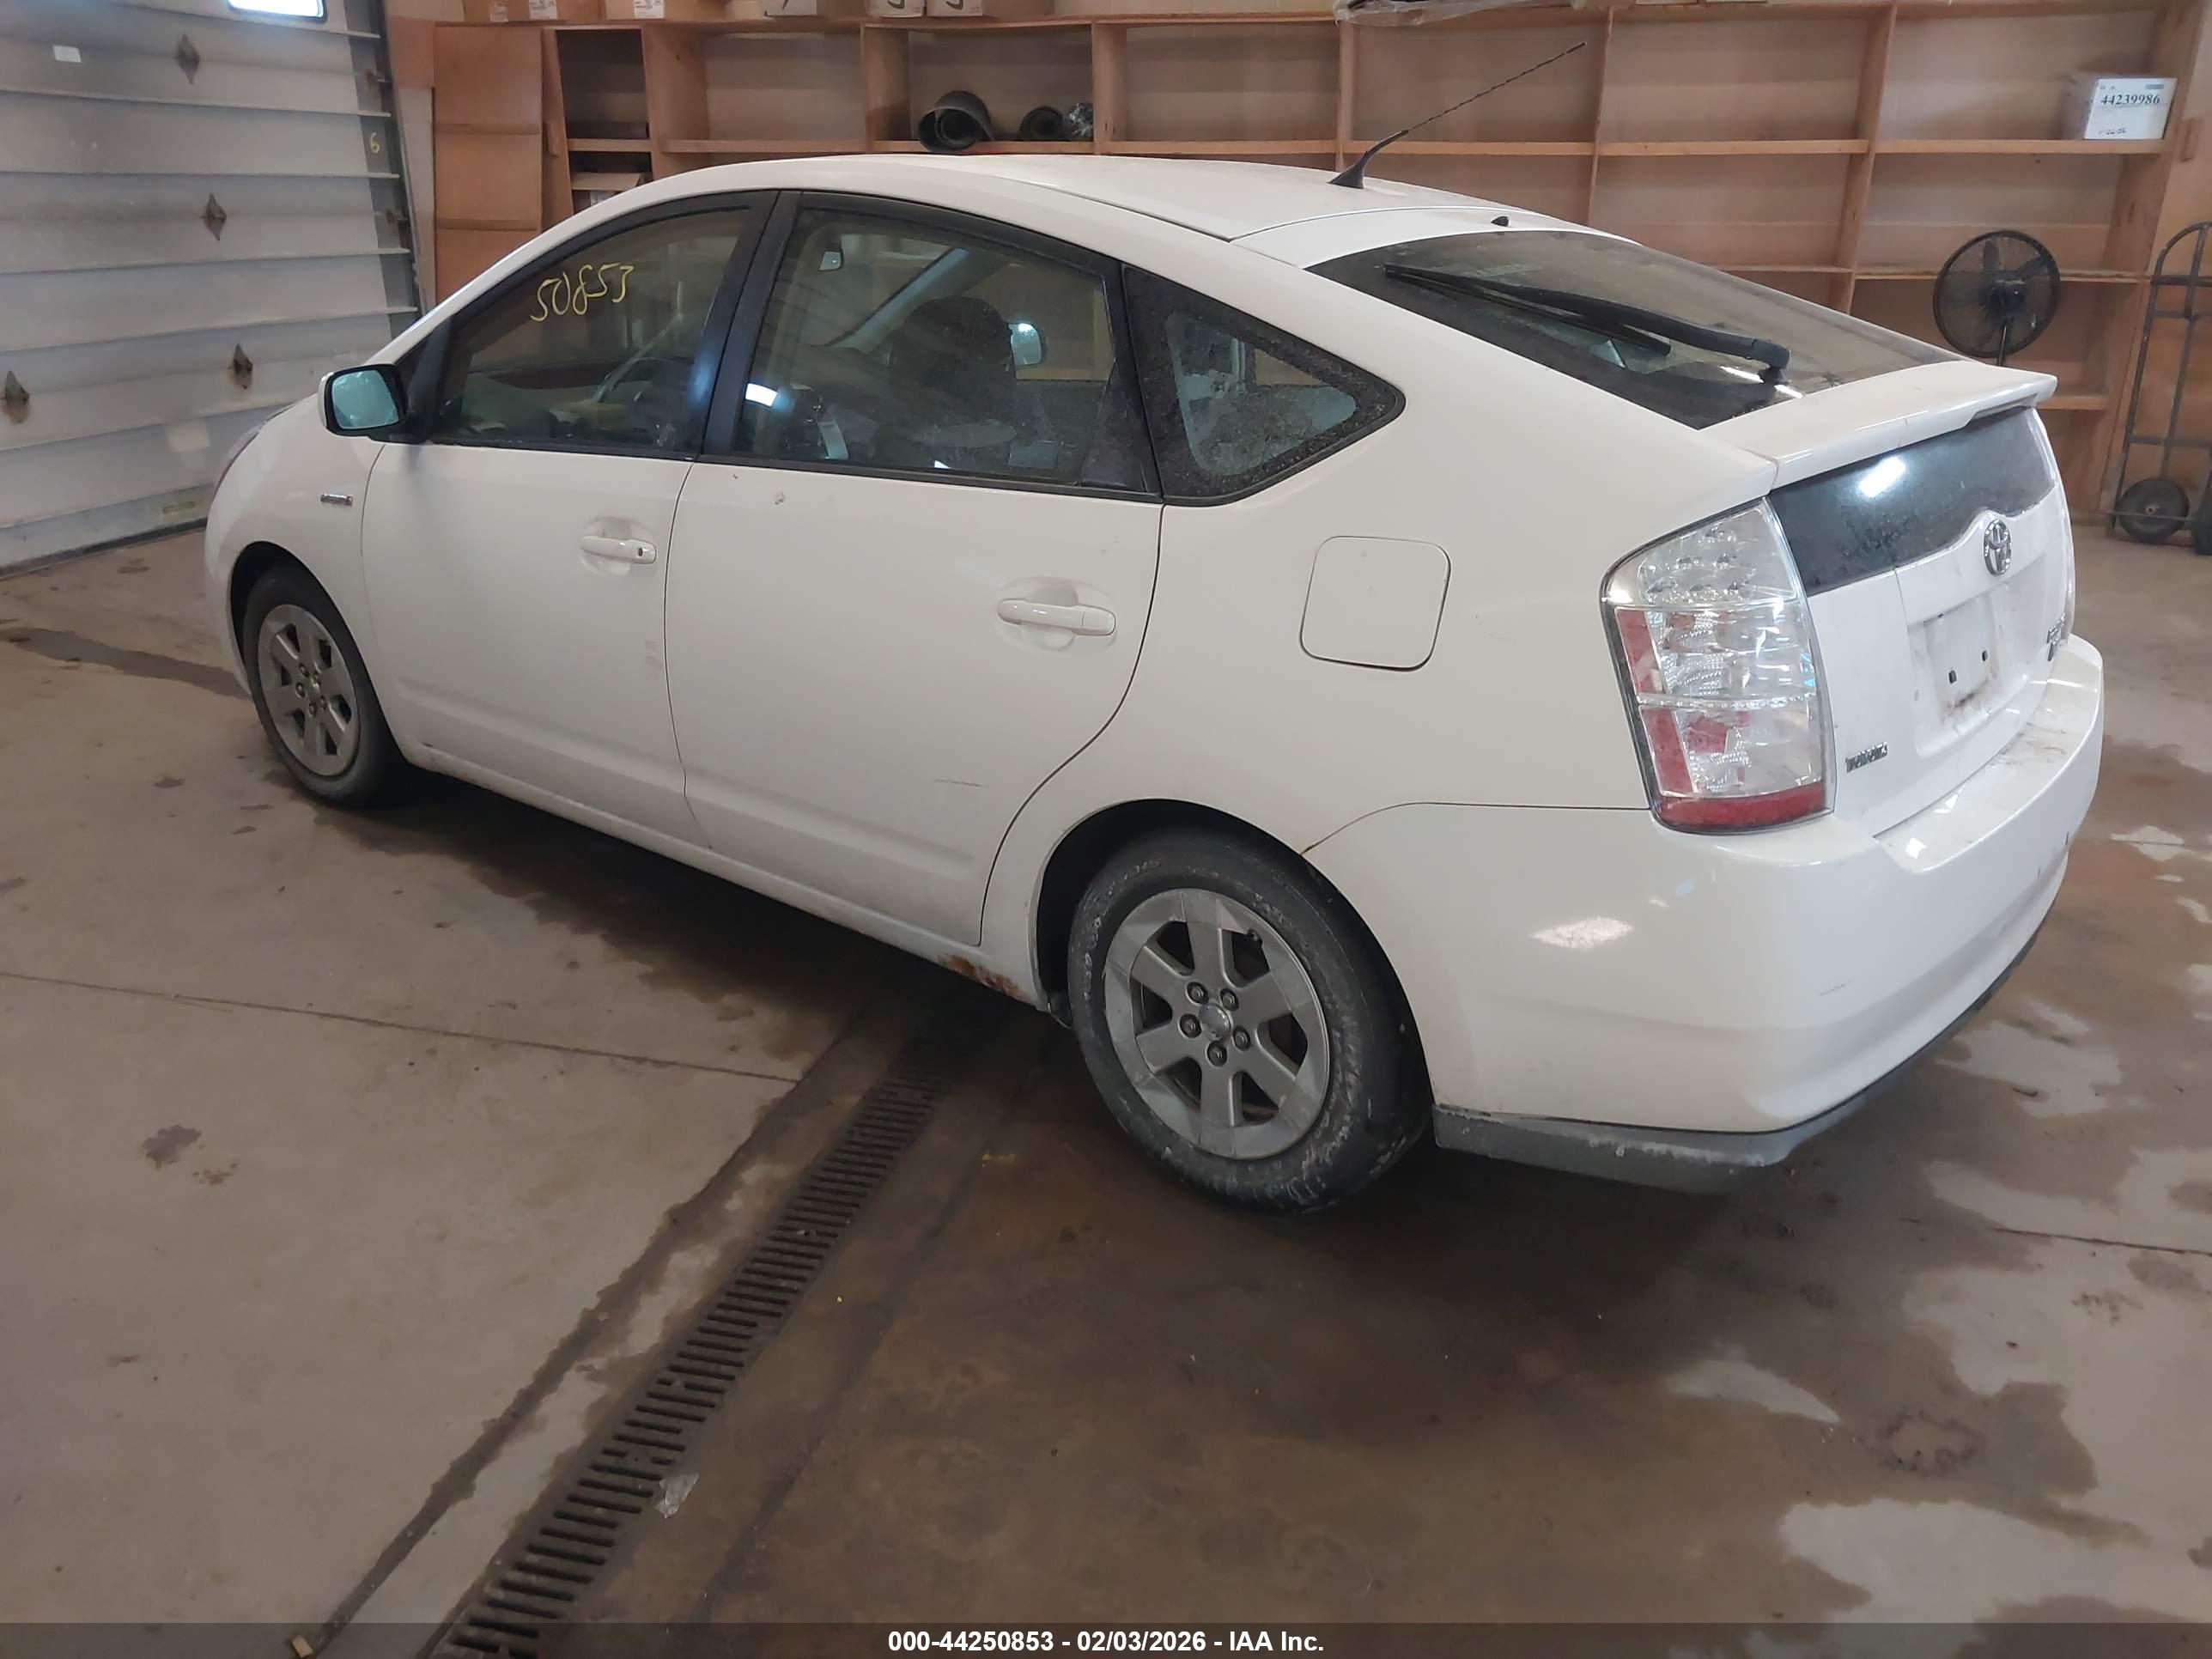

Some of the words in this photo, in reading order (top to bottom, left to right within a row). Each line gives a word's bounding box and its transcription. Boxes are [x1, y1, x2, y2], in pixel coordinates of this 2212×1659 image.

[2100, 93, 2160, 105] 44239986
[369, 131, 380, 154] 6
[530, 262, 635, 322] 50853
